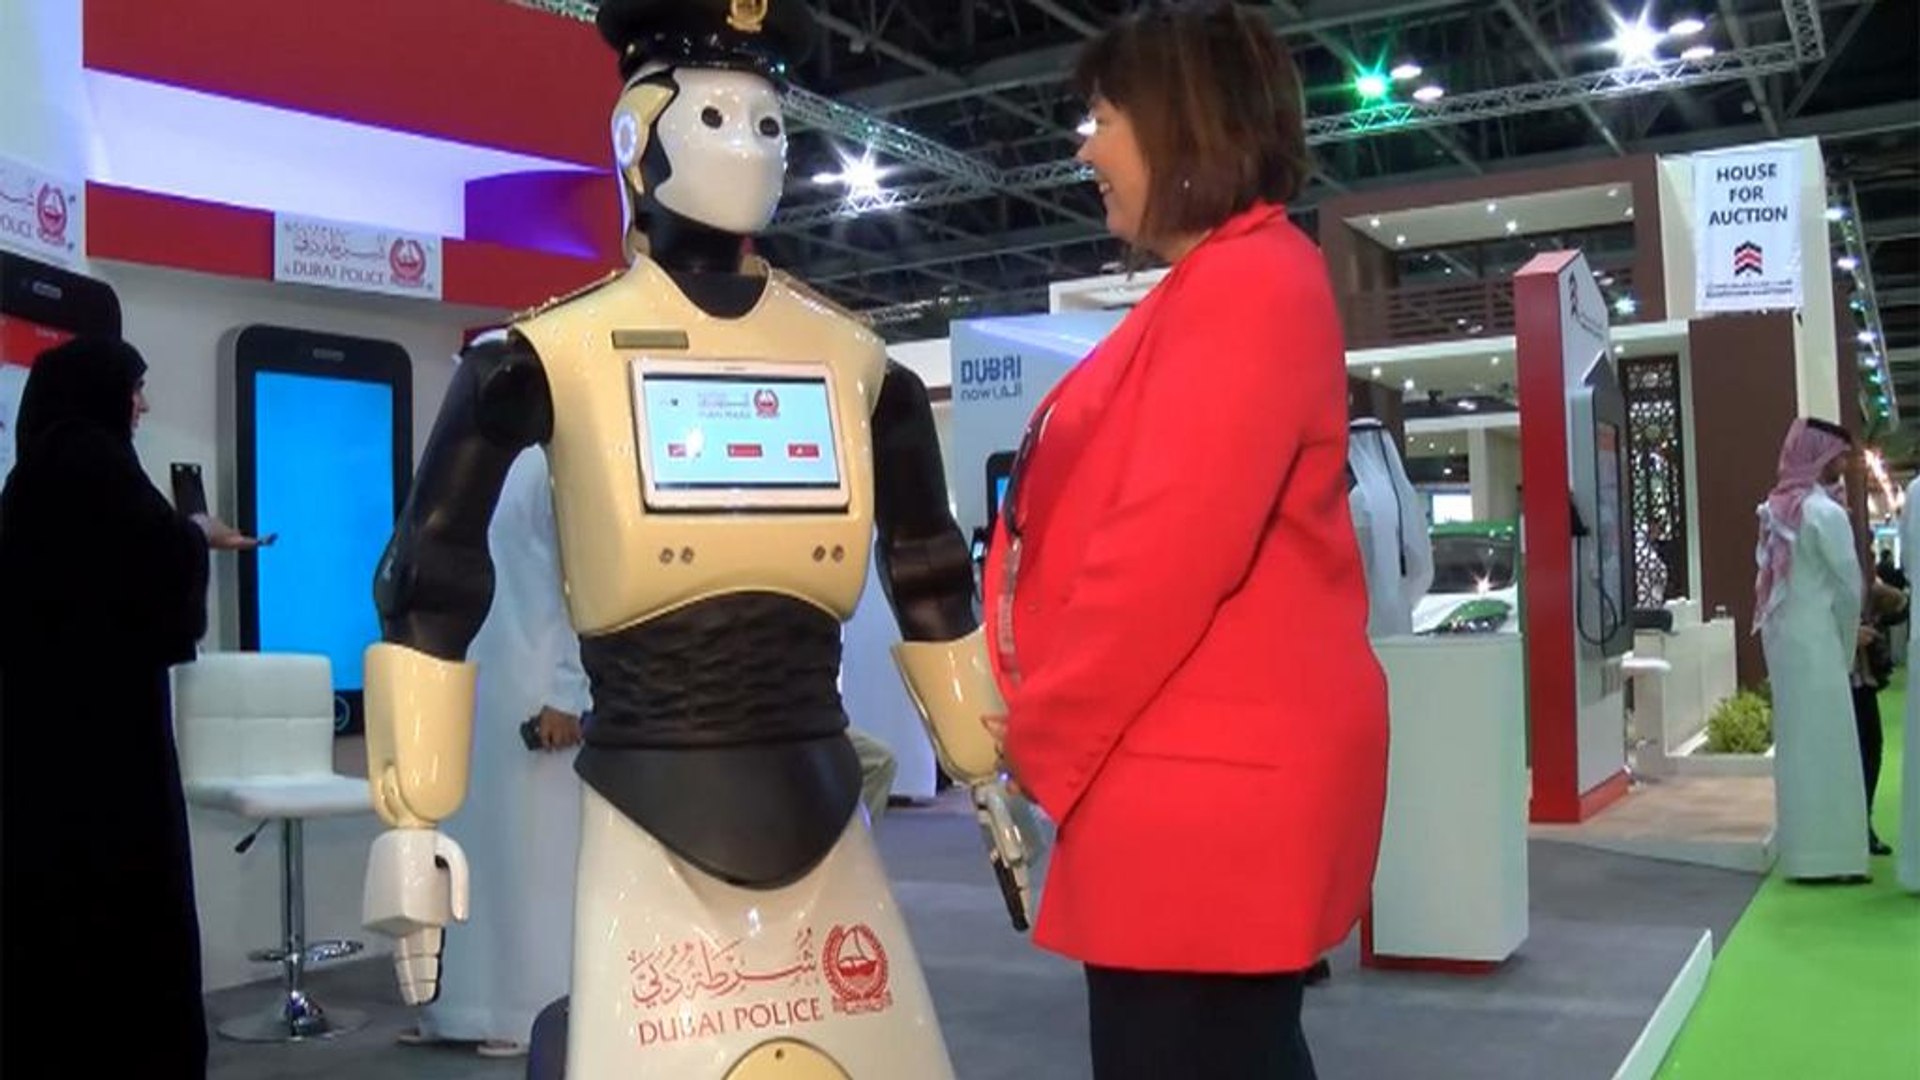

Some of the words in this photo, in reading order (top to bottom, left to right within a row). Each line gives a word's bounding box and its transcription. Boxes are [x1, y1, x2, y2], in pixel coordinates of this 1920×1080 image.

[1716, 163, 1777, 182] HOUSE
[1730, 186, 1764, 203] FOR
[1709, 206, 1788, 226] AUCTION
[293, 260, 336, 279] DUBAI
[340, 266, 384, 284] POLICE
[961, 355, 1021, 384] DUBAI
[638, 1011, 724, 1046] DUBAI
[735, 998, 824, 1031] POLICE
